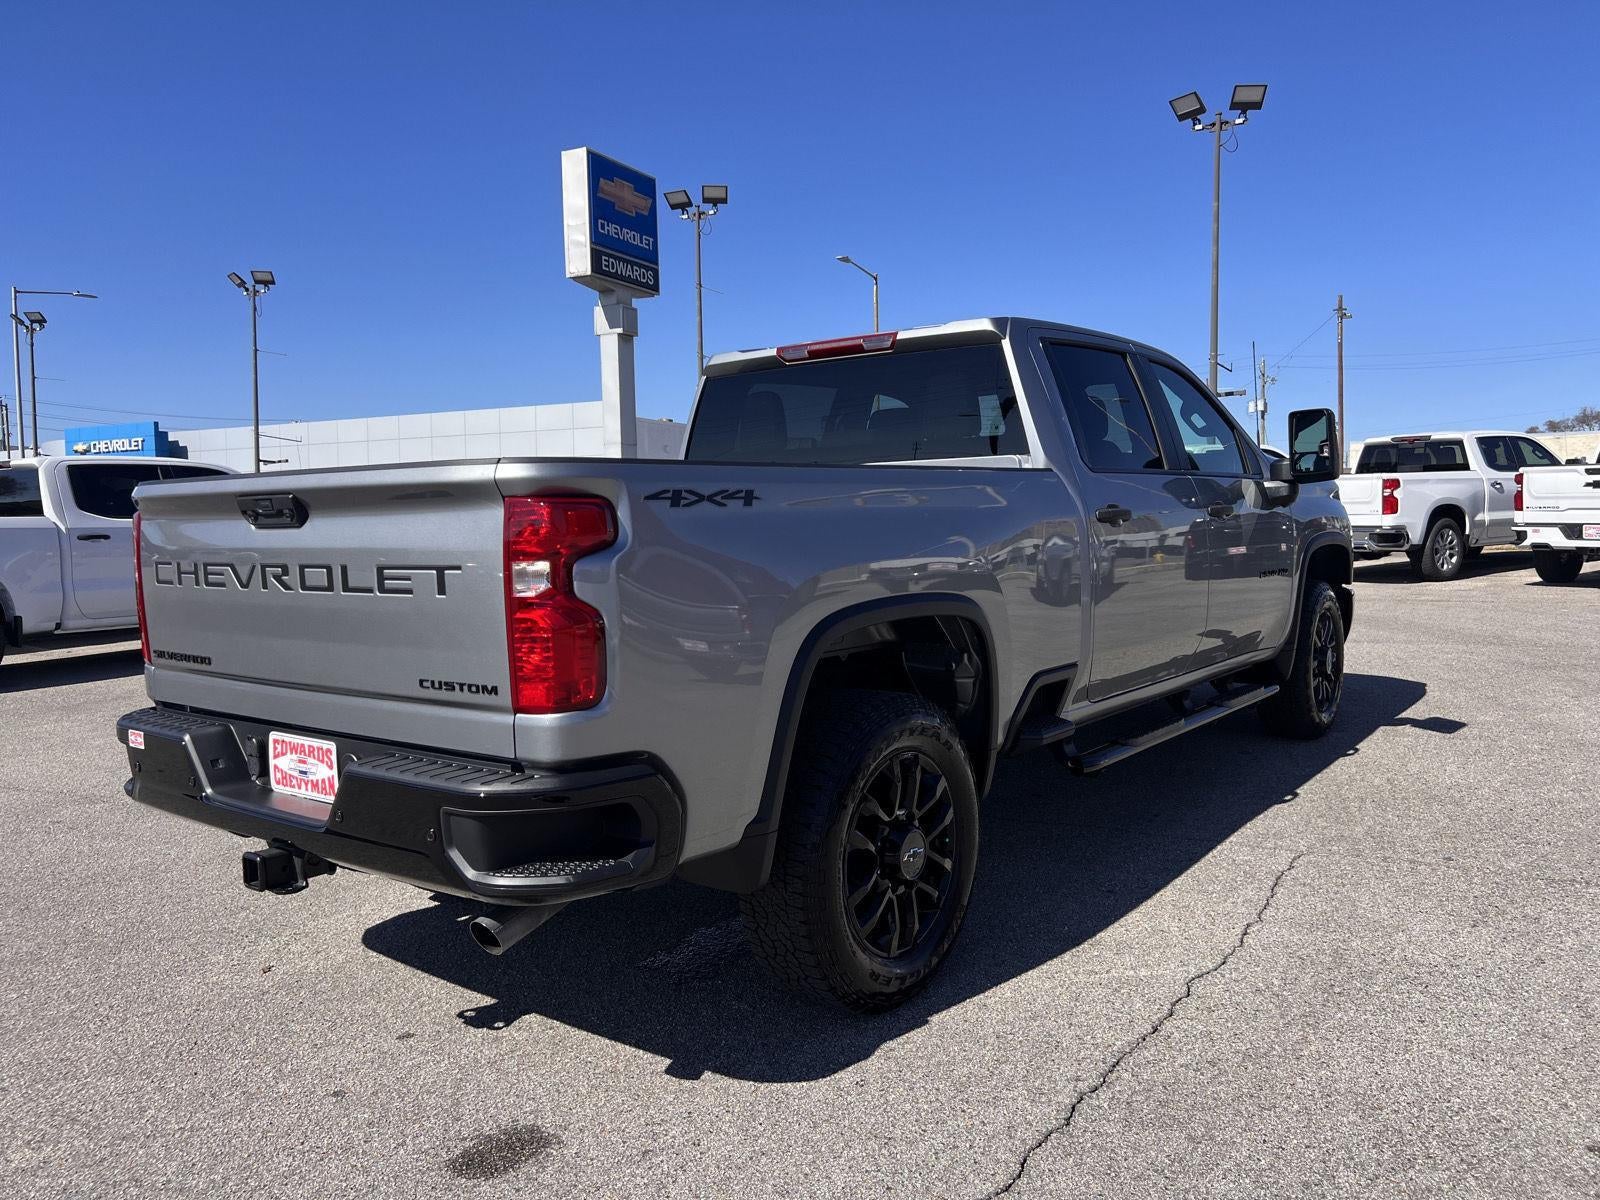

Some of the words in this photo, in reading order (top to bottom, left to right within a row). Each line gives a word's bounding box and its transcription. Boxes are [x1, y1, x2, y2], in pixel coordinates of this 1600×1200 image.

[598, 219, 653, 250] CHEVROLET
[602, 256, 653, 285] EDWARDS
[90, 437, 144, 453] CHEVROLET
[154, 561, 462, 597] CHEVROLET
[153, 649, 212, 666] SILVERADO
[418, 678, 499, 696] CUSTOM
[272, 738, 334, 770] EDWARDS
[273, 763, 337, 797] CHEVYMAN
